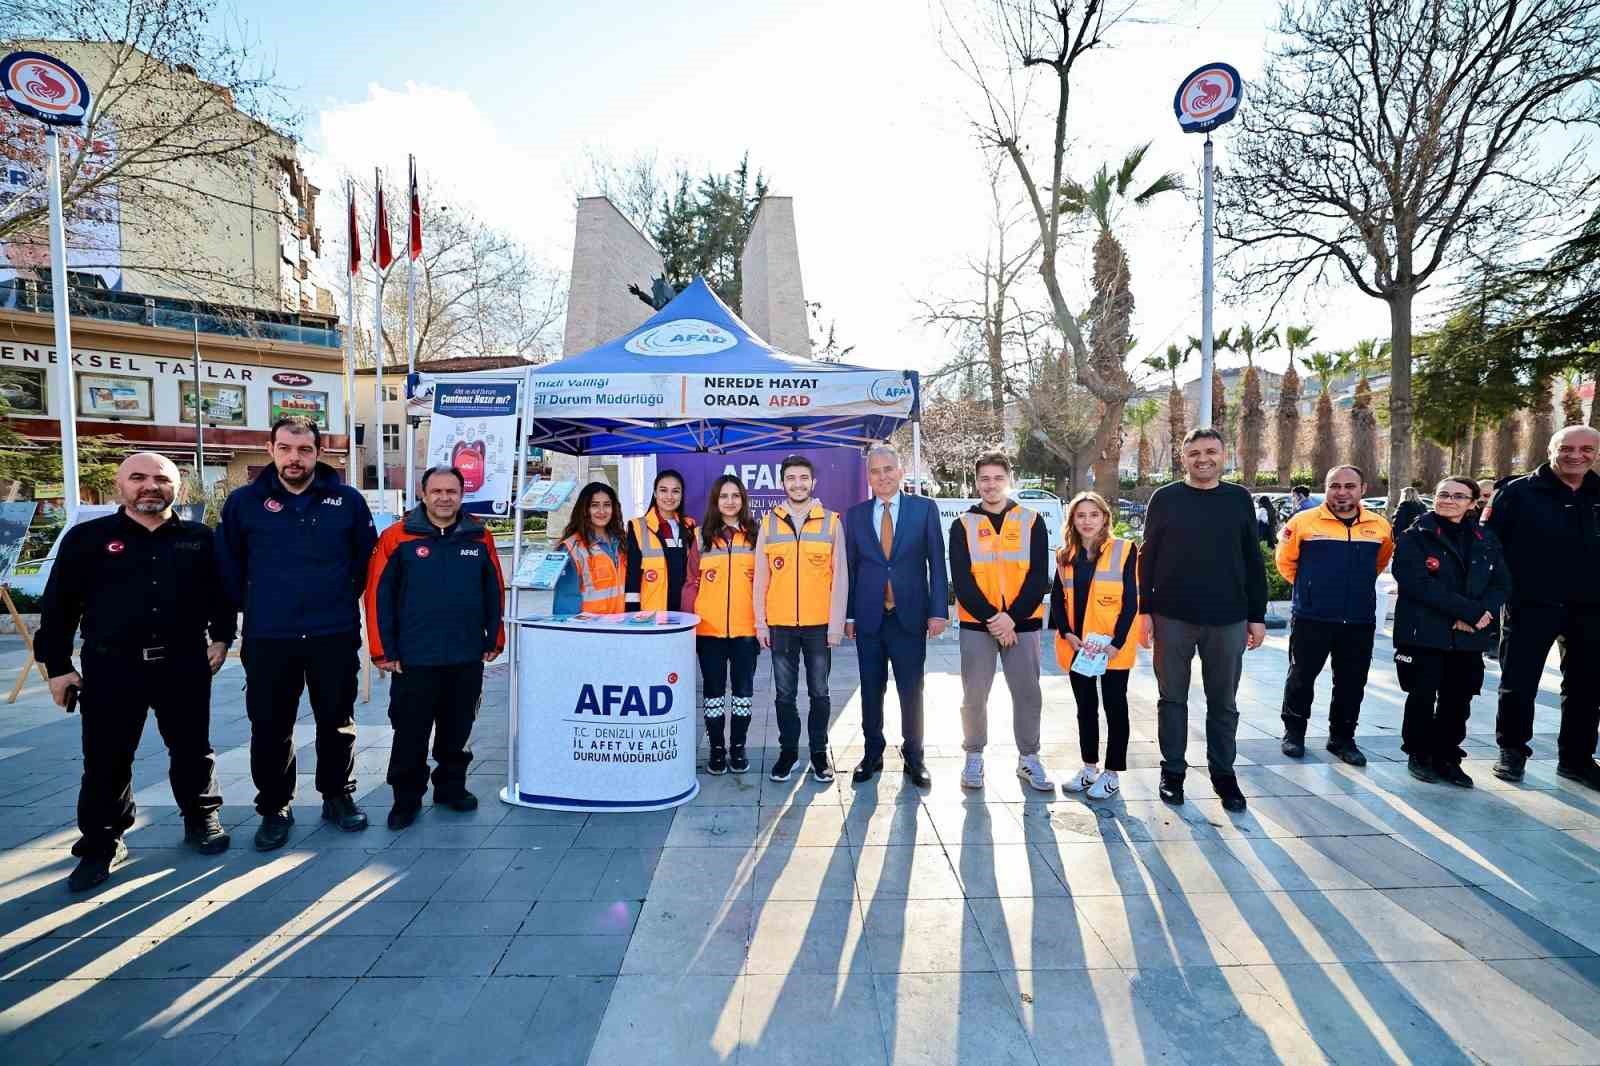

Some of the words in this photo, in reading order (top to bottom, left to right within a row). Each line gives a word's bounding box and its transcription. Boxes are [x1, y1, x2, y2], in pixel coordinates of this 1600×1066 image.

[669, 334, 727, 344] AFAD
[568, 377, 609, 390] Valiliği
[704, 376, 764, 389] NEREDE
[769, 378, 819, 389] HAYAT
[550, 394, 592, 405] Durum
[596, 393, 664, 407] Müdürlüğü
[703, 394, 760, 407] ORADA
[768, 395, 811, 407] AFAD
[574, 683, 674, 717] AFAD
[590, 740, 622, 750] AFET
[628, 741, 644, 751] VE
[573, 752, 610, 762] DURUM
[613, 749, 678, 763] MÜDÜRLÜĞÜ
